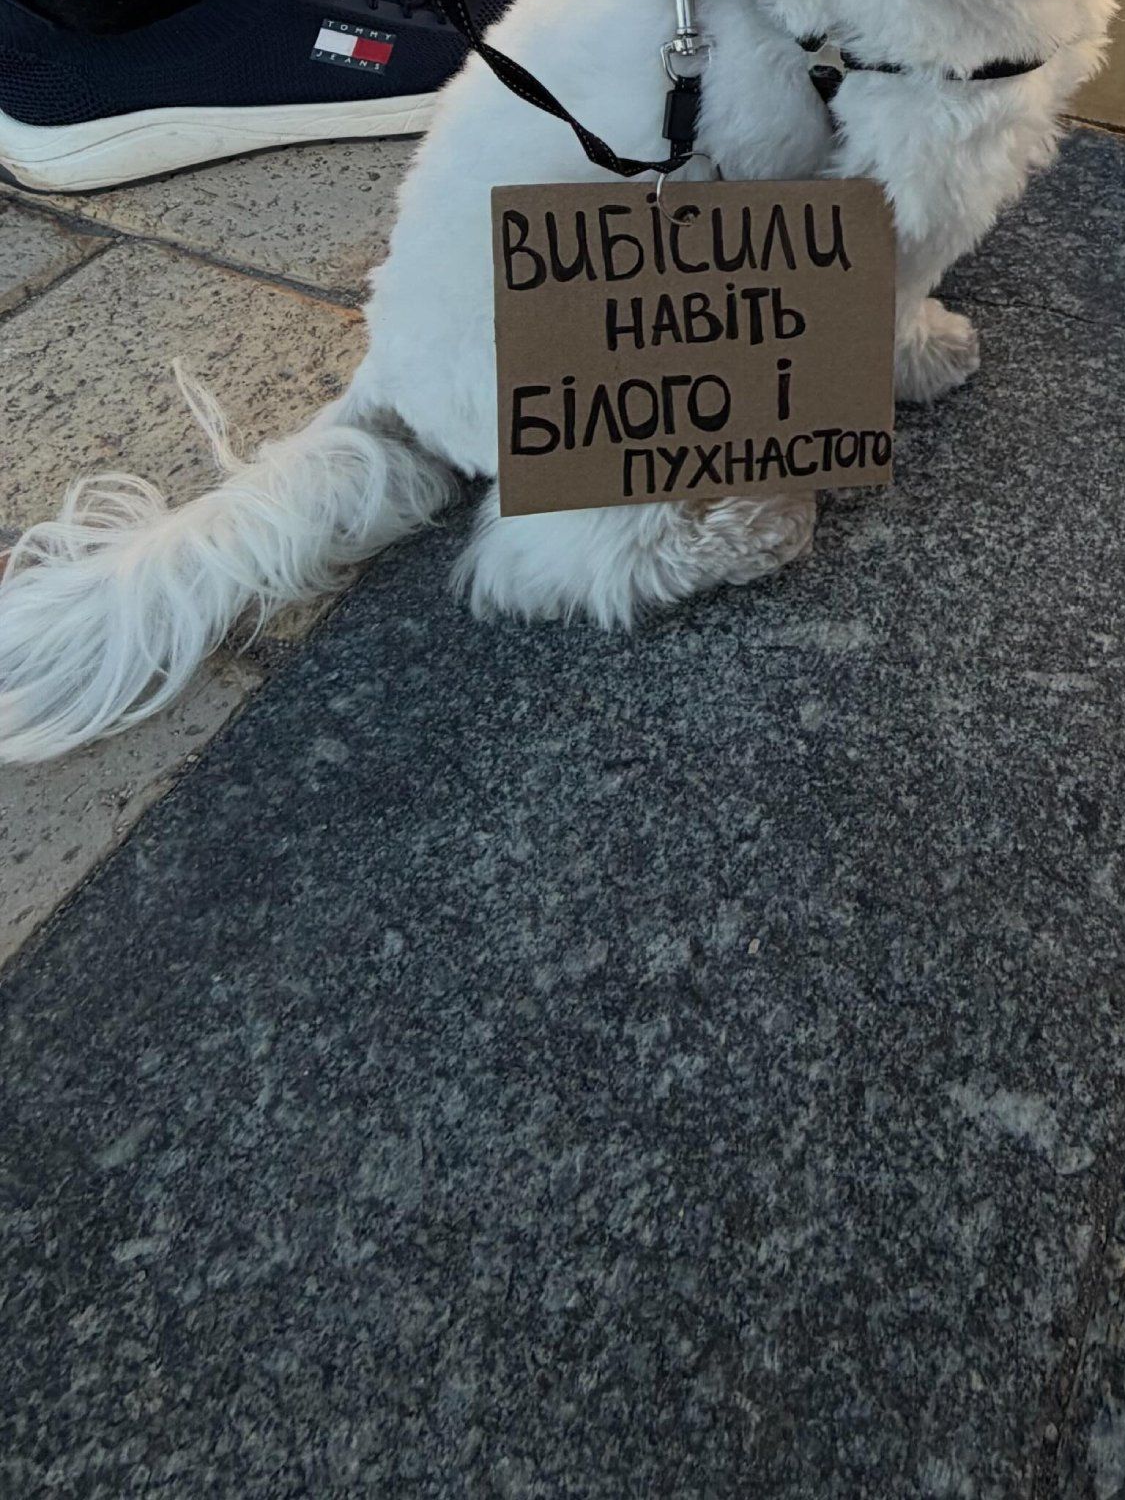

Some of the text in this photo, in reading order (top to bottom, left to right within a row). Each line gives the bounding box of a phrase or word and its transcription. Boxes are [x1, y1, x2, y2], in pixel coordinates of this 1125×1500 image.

[315, 50, 380, 71] JEANS
[327, 20, 392, 40] TOMMY
[502, 192, 852, 291] ВИБІСИЛИ
[605, 283, 806, 351] НАВІТЬ
[510, 374, 732, 456] БІЛОГО
[622, 428, 893, 497] ПУХНАСТОГО
